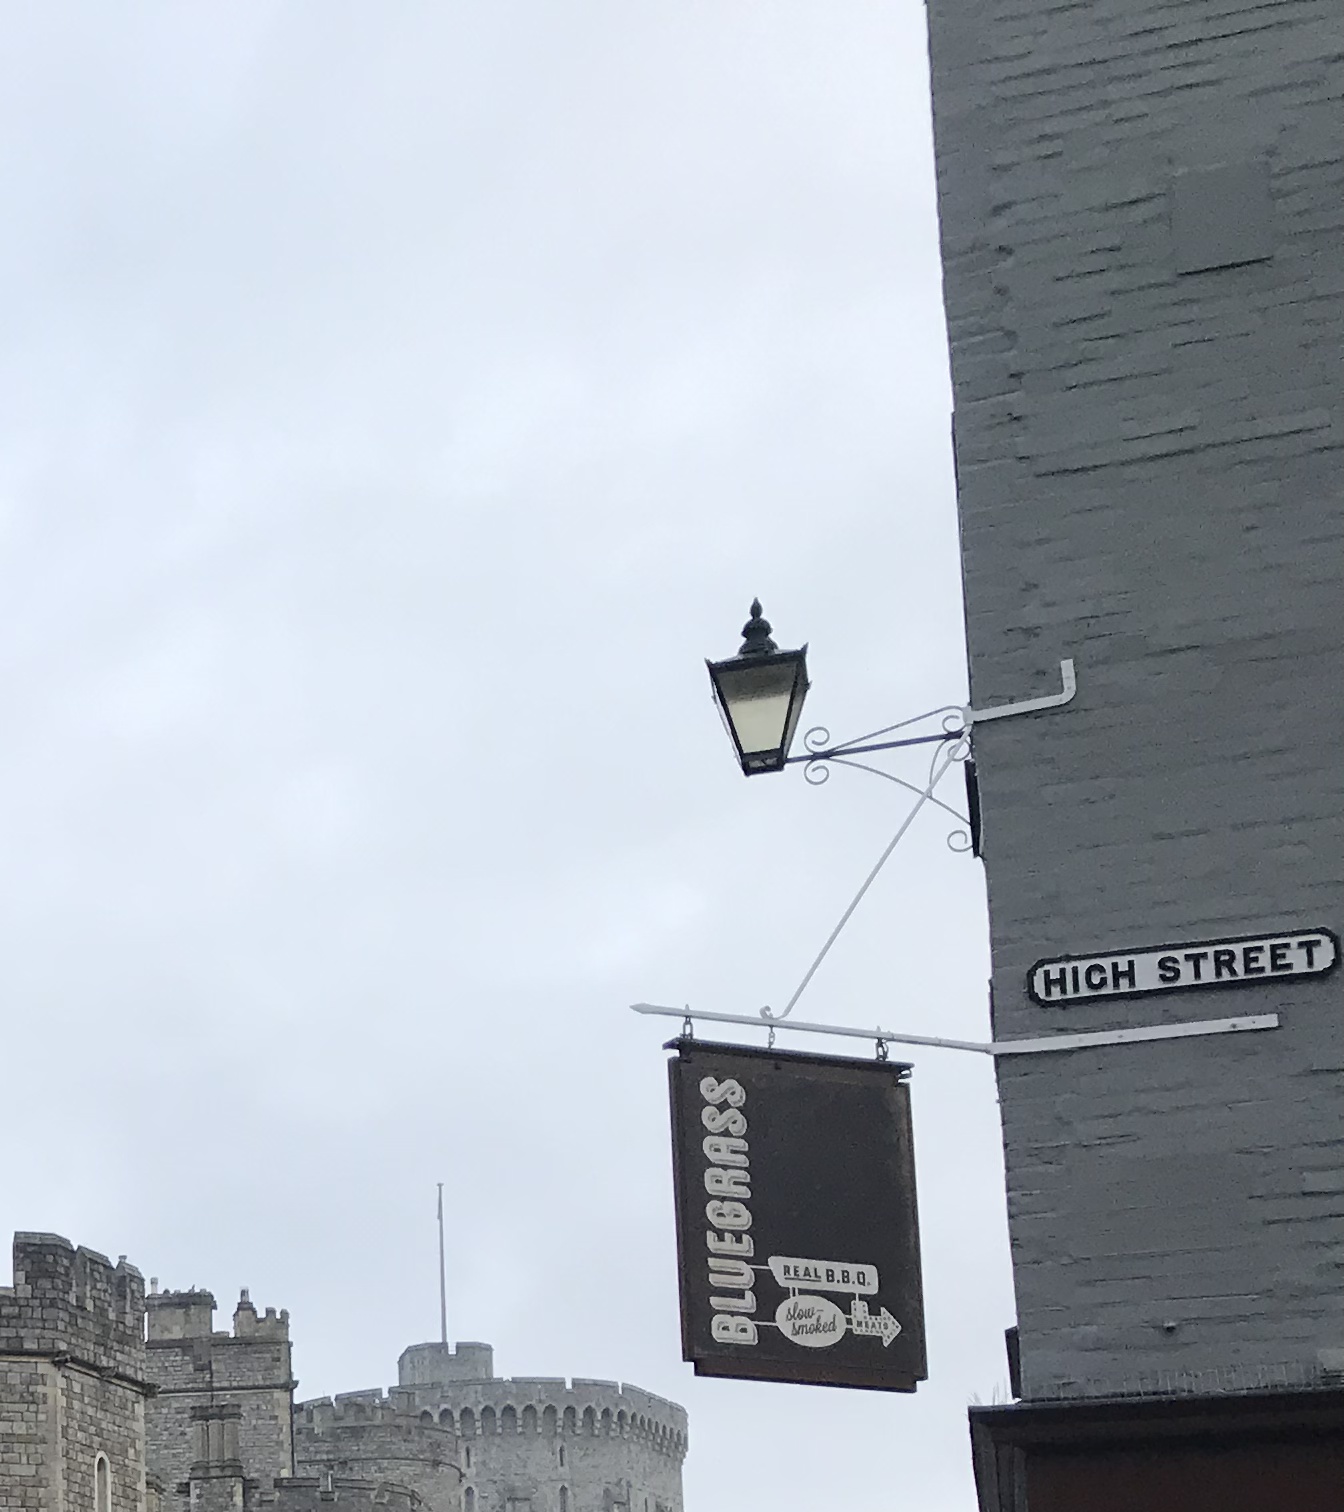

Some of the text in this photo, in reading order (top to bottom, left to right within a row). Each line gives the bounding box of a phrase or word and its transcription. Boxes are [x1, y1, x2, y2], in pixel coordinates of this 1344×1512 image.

[1043, 939, 1322, 997] HIGH STREET
[700, 1076, 759, 1346] BLUEGRASS
[783, 1264, 822, 1279] REAL
[791, 1314, 838, 1337] smoked
